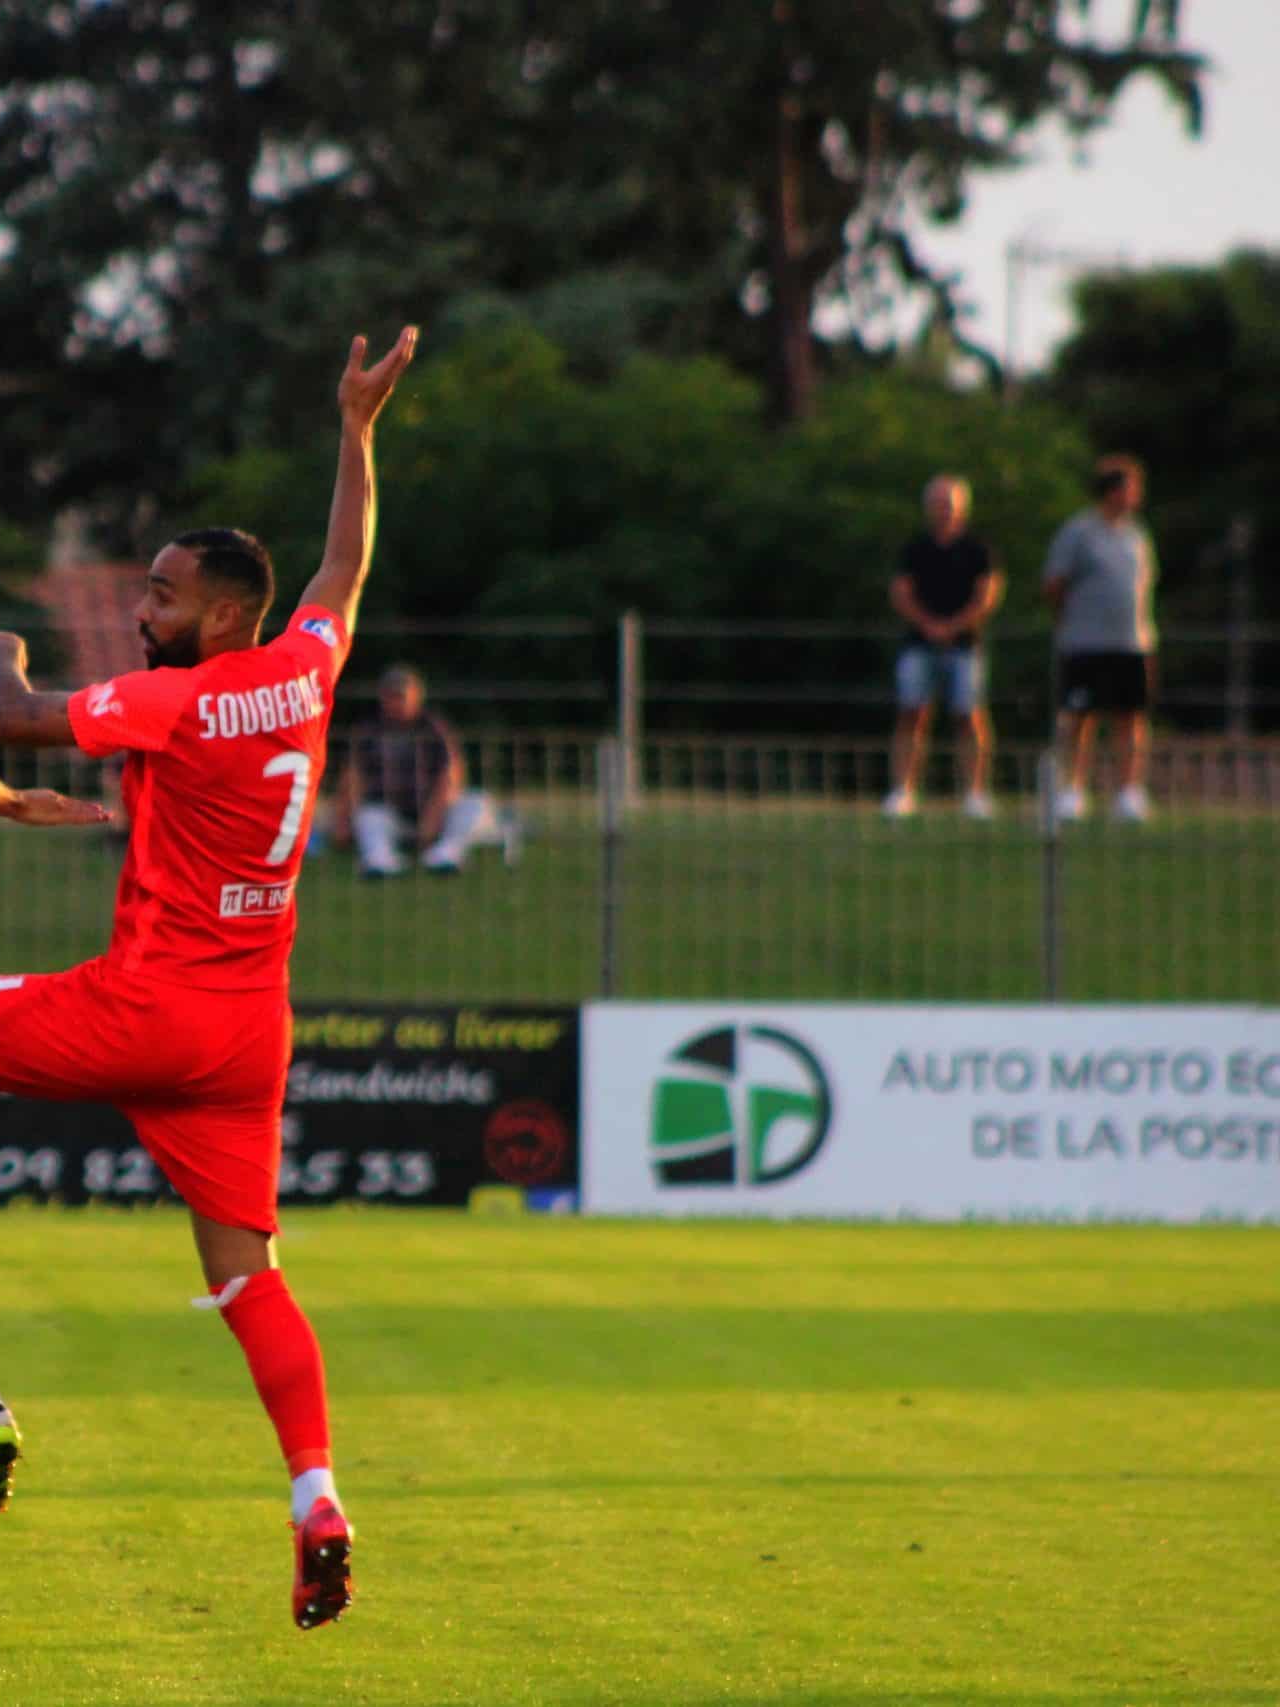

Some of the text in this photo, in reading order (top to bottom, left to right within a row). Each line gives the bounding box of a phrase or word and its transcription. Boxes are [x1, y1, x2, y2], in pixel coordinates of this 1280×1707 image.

[263, 751, 311, 864] 7
[882, 1050, 1033, 1094] AUTO
[1048, 1050, 1213, 1095] MOTO
[970, 1114, 1280, 1162] DE LA POST
[83, 1148, 156, 1194] 82
[357, 1152, 432, 1195] 33
